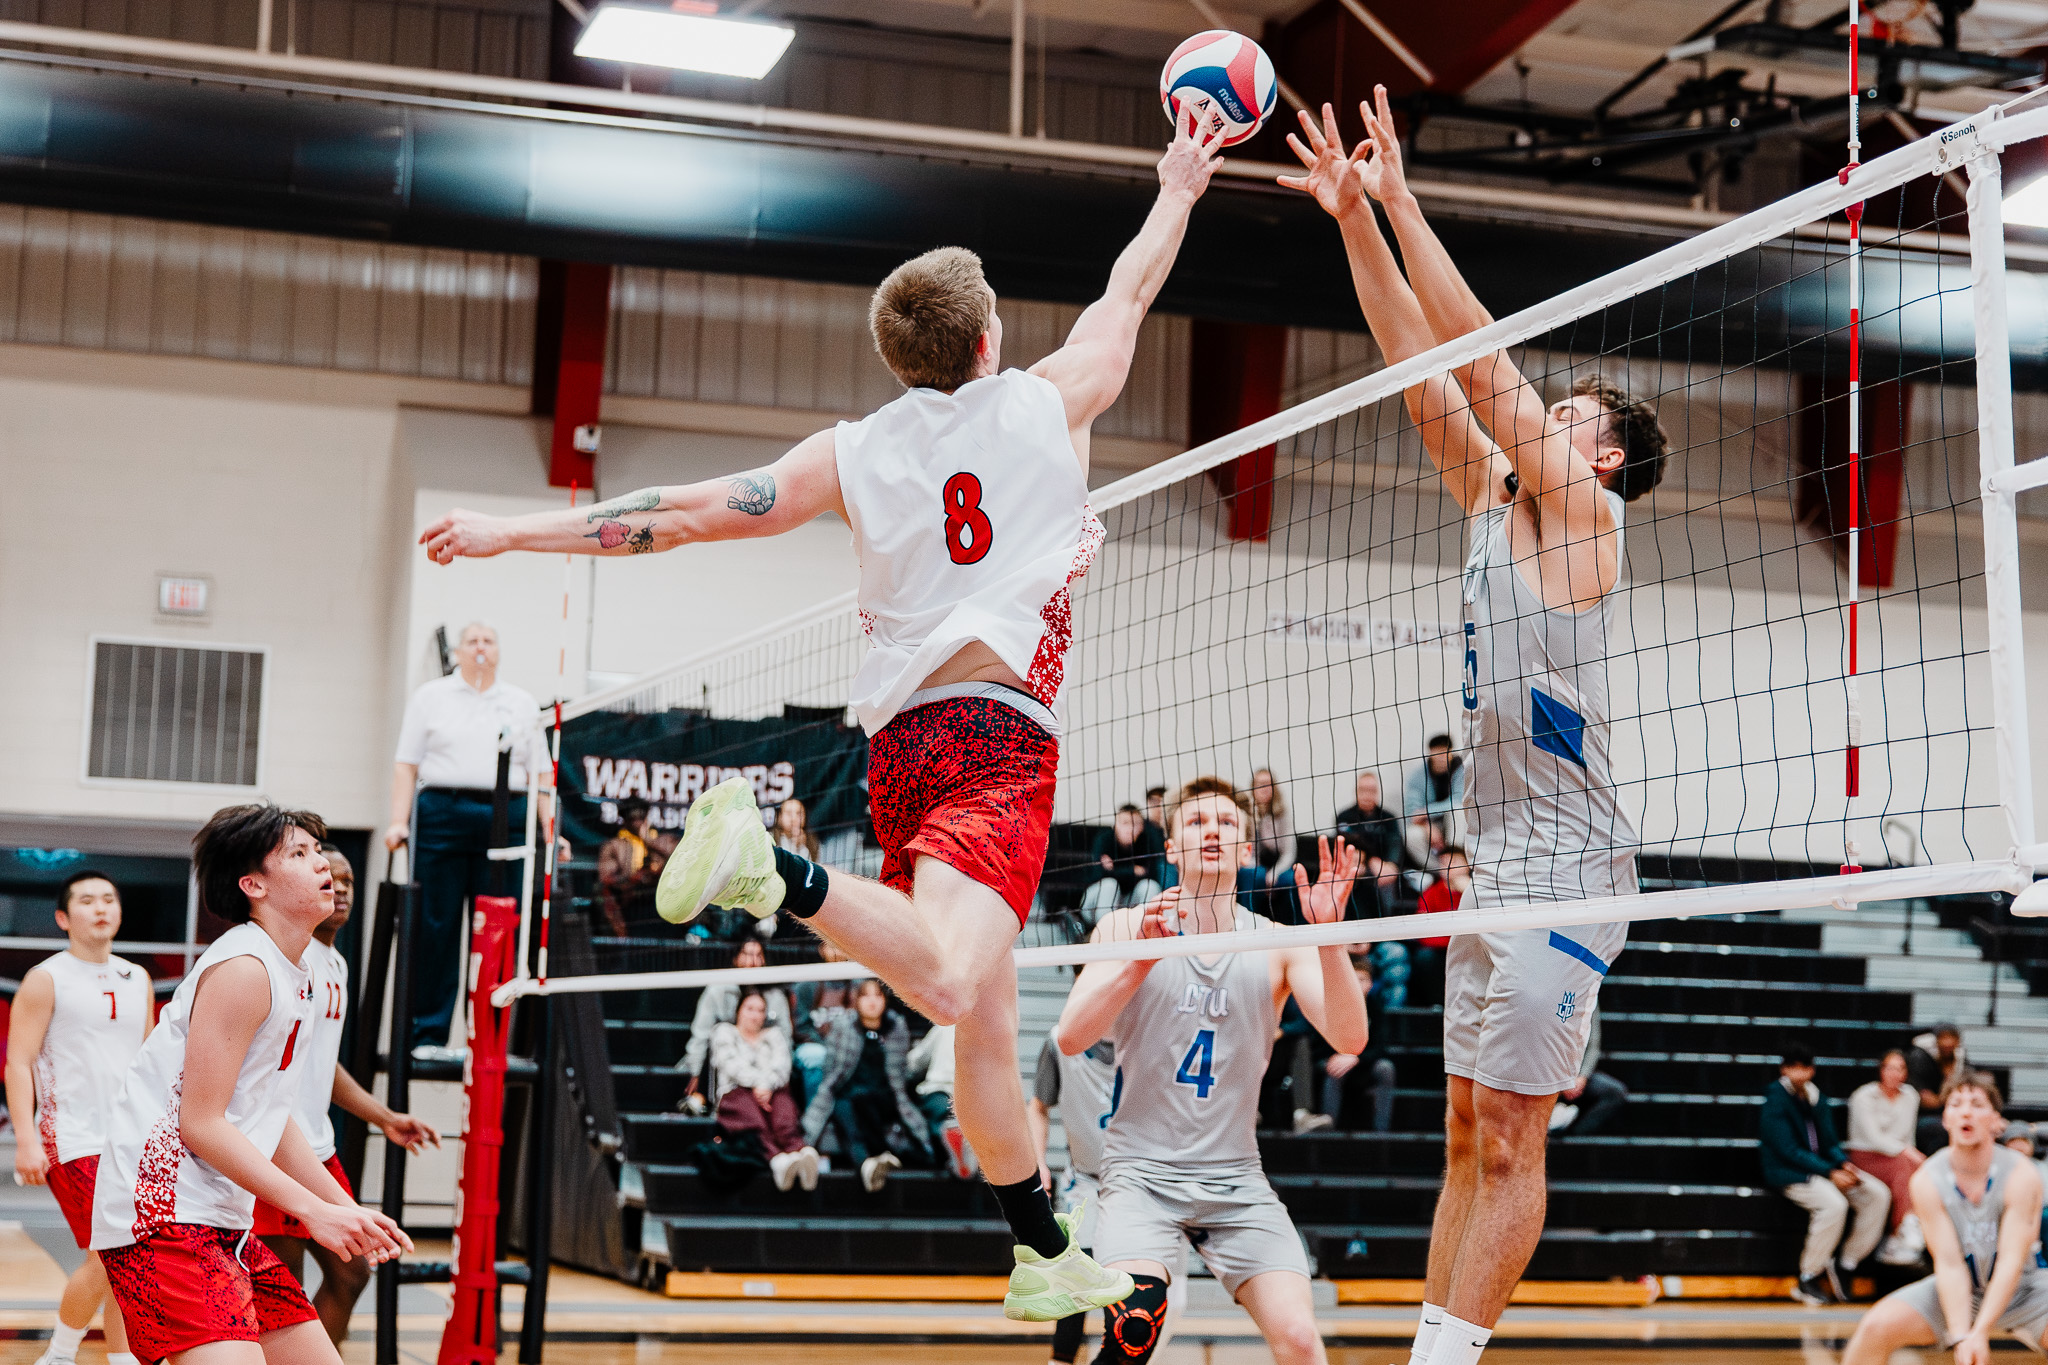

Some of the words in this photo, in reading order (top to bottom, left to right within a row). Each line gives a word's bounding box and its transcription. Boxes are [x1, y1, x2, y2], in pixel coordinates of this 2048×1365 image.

[1218, 87, 1245, 122] molten
[1947, 123, 1976, 142] Senoh
[942, 471, 993, 565] 8
[102, 990, 117, 1020] 7
[1173, 1026, 1219, 1102] 4
